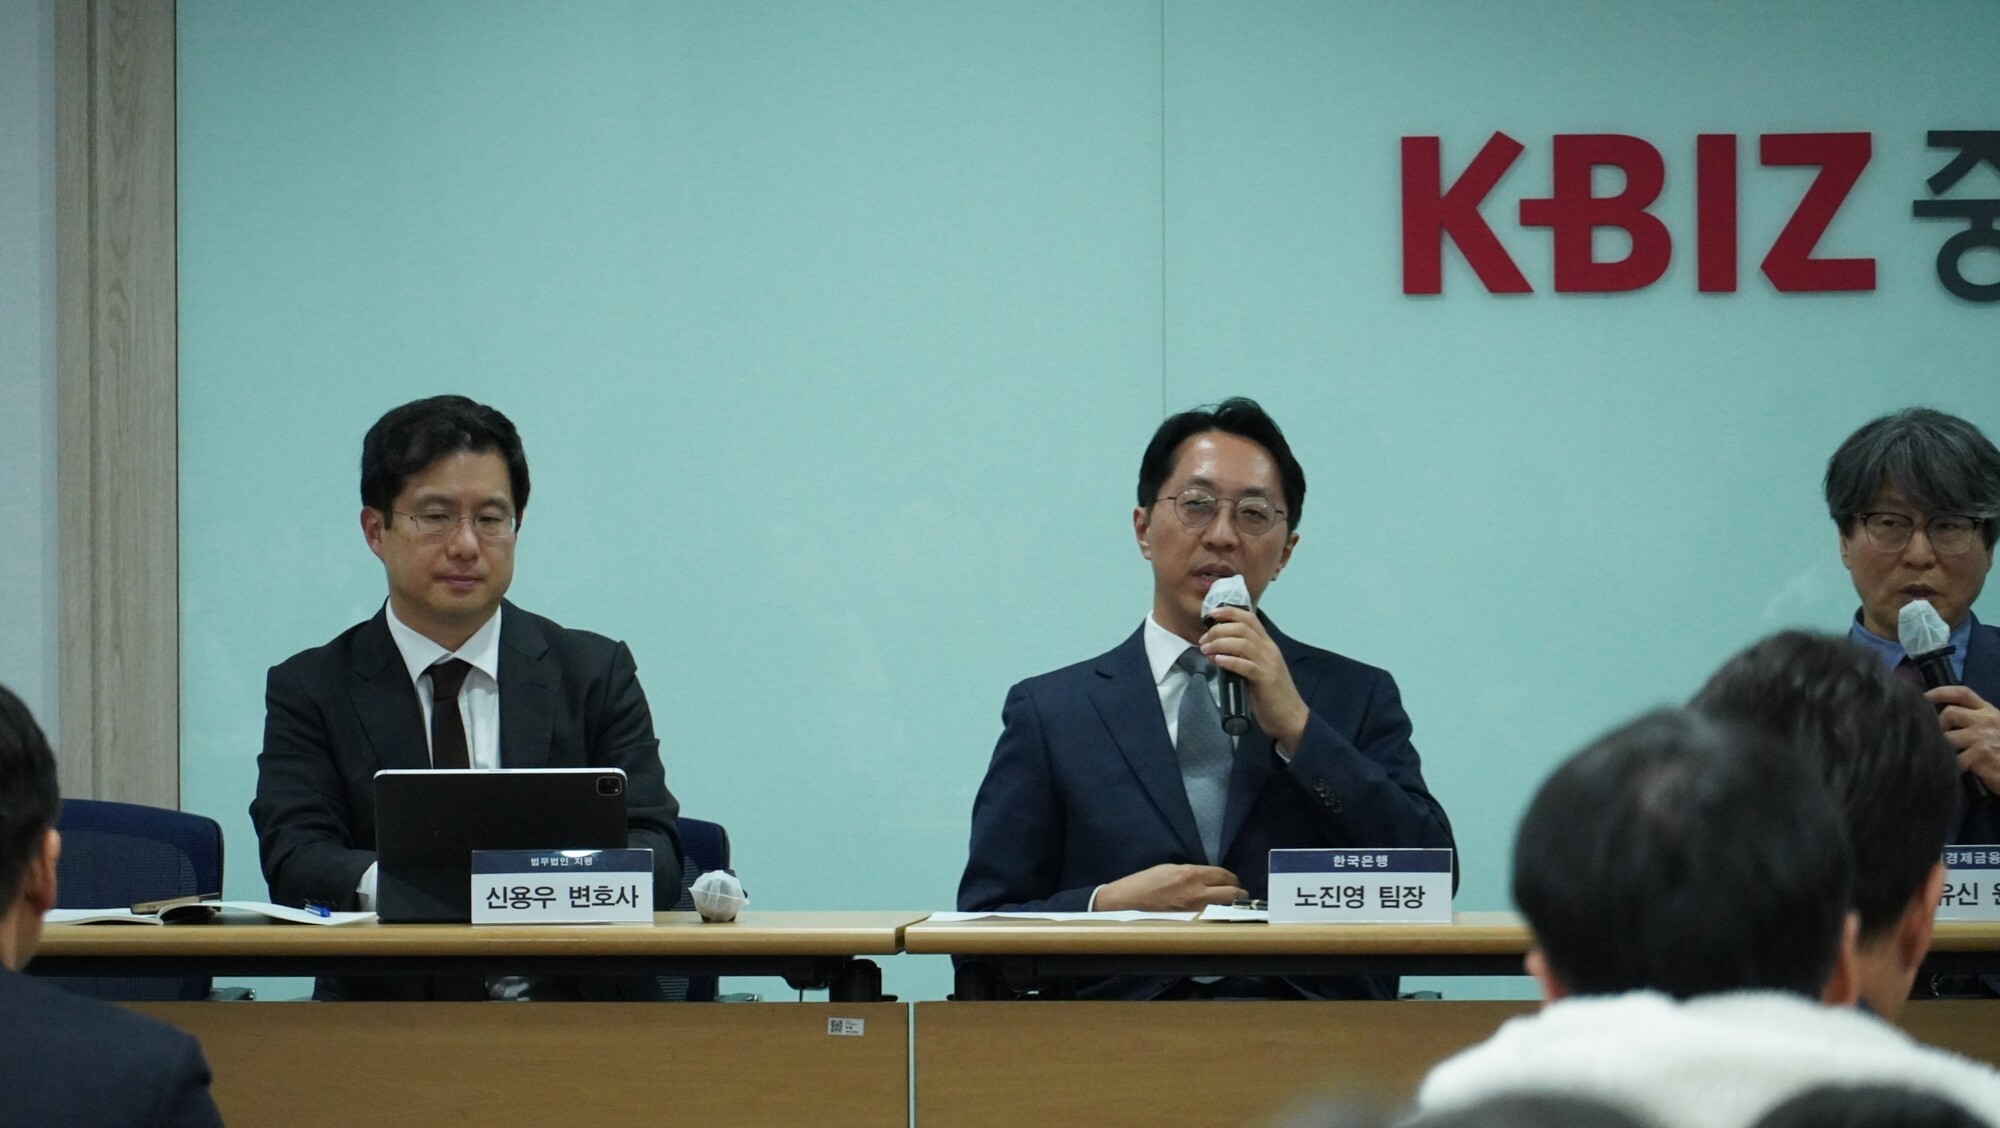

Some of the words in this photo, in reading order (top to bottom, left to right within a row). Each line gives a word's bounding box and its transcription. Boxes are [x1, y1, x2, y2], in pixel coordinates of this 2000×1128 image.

[1401, 130, 1876, 295] KBIZ
[530, 857, 569, 867] 법무법인
[574, 857, 594, 866] 지평
[1333, 855, 1388, 868] 한국은행
[486, 885, 556, 910] 신용우
[569, 884, 638, 908] 변호사
[1294, 885, 1365, 909] 노진영
[1379, 885, 1425, 909] 팀장
